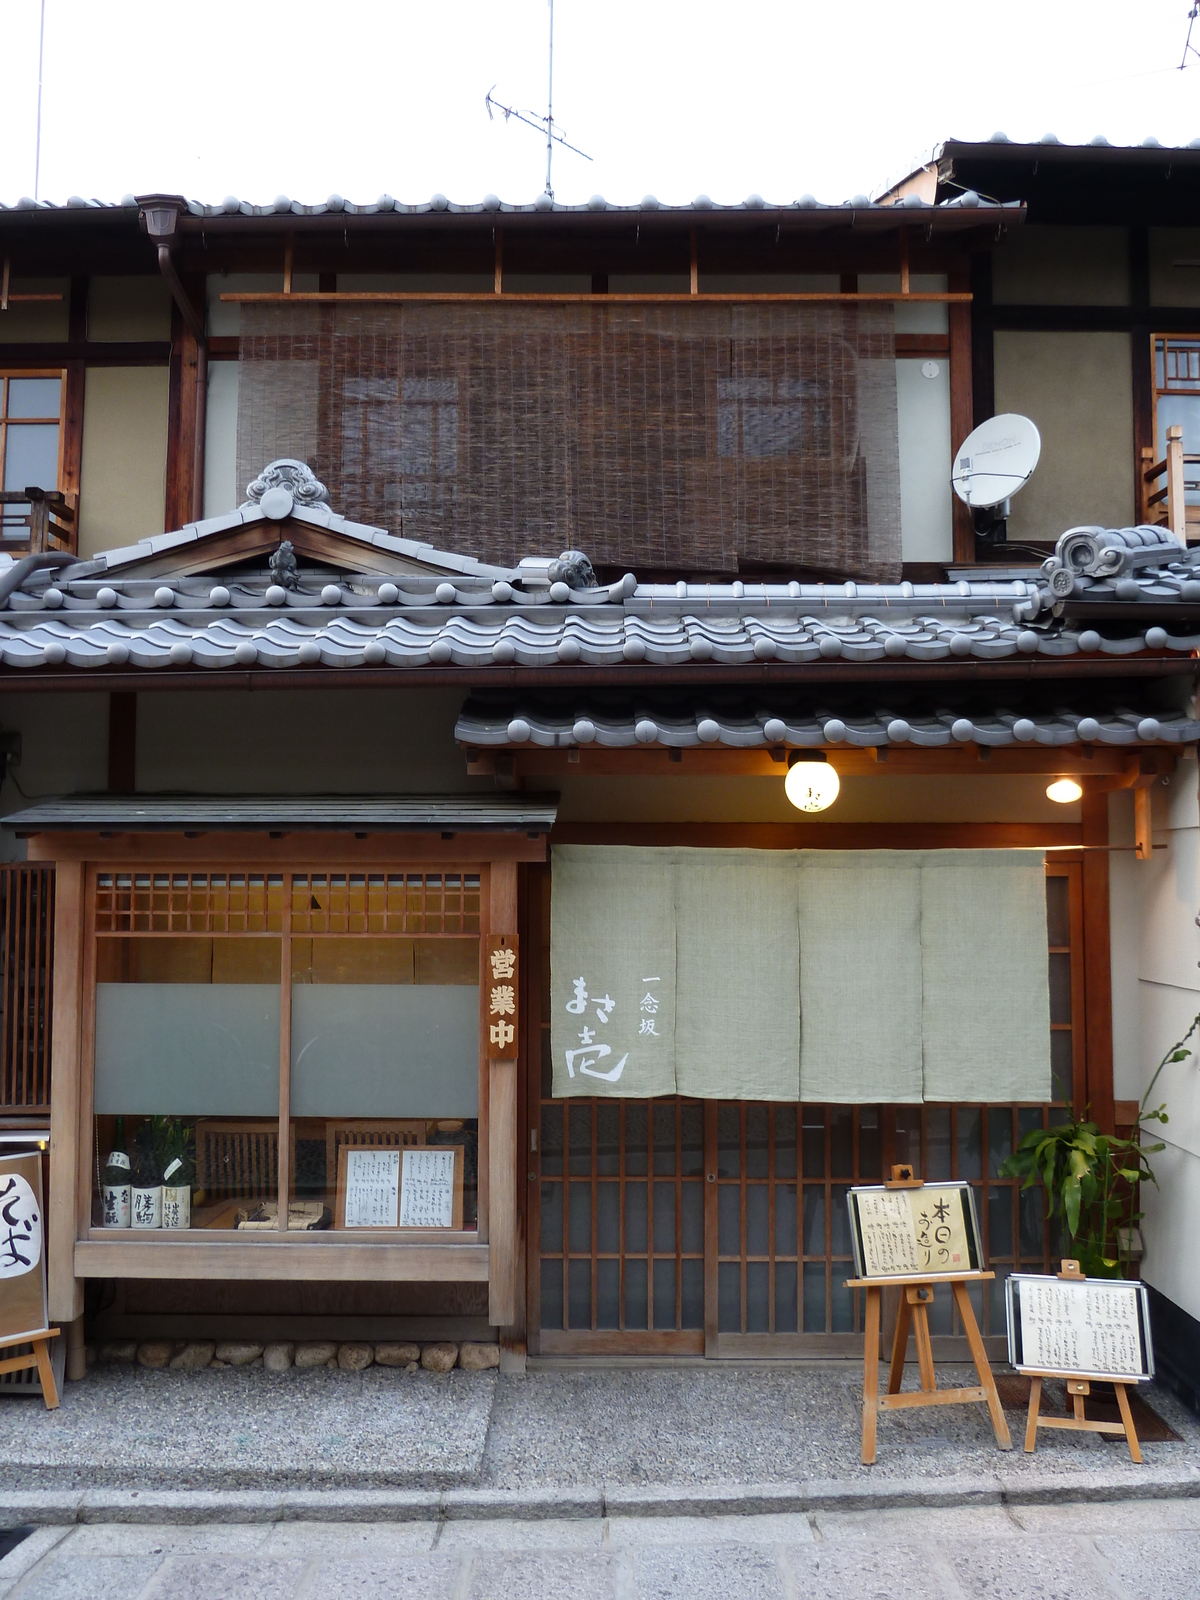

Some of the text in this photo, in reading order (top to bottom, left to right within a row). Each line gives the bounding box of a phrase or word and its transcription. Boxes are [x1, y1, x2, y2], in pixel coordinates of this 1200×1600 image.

[489, 948, 516, 1049] 営業中
[638, 977, 661, 1036] 一念坂
[134, 1194, 154, 1224] 勝駒
[932, 1197, 952, 1265] 本日の
